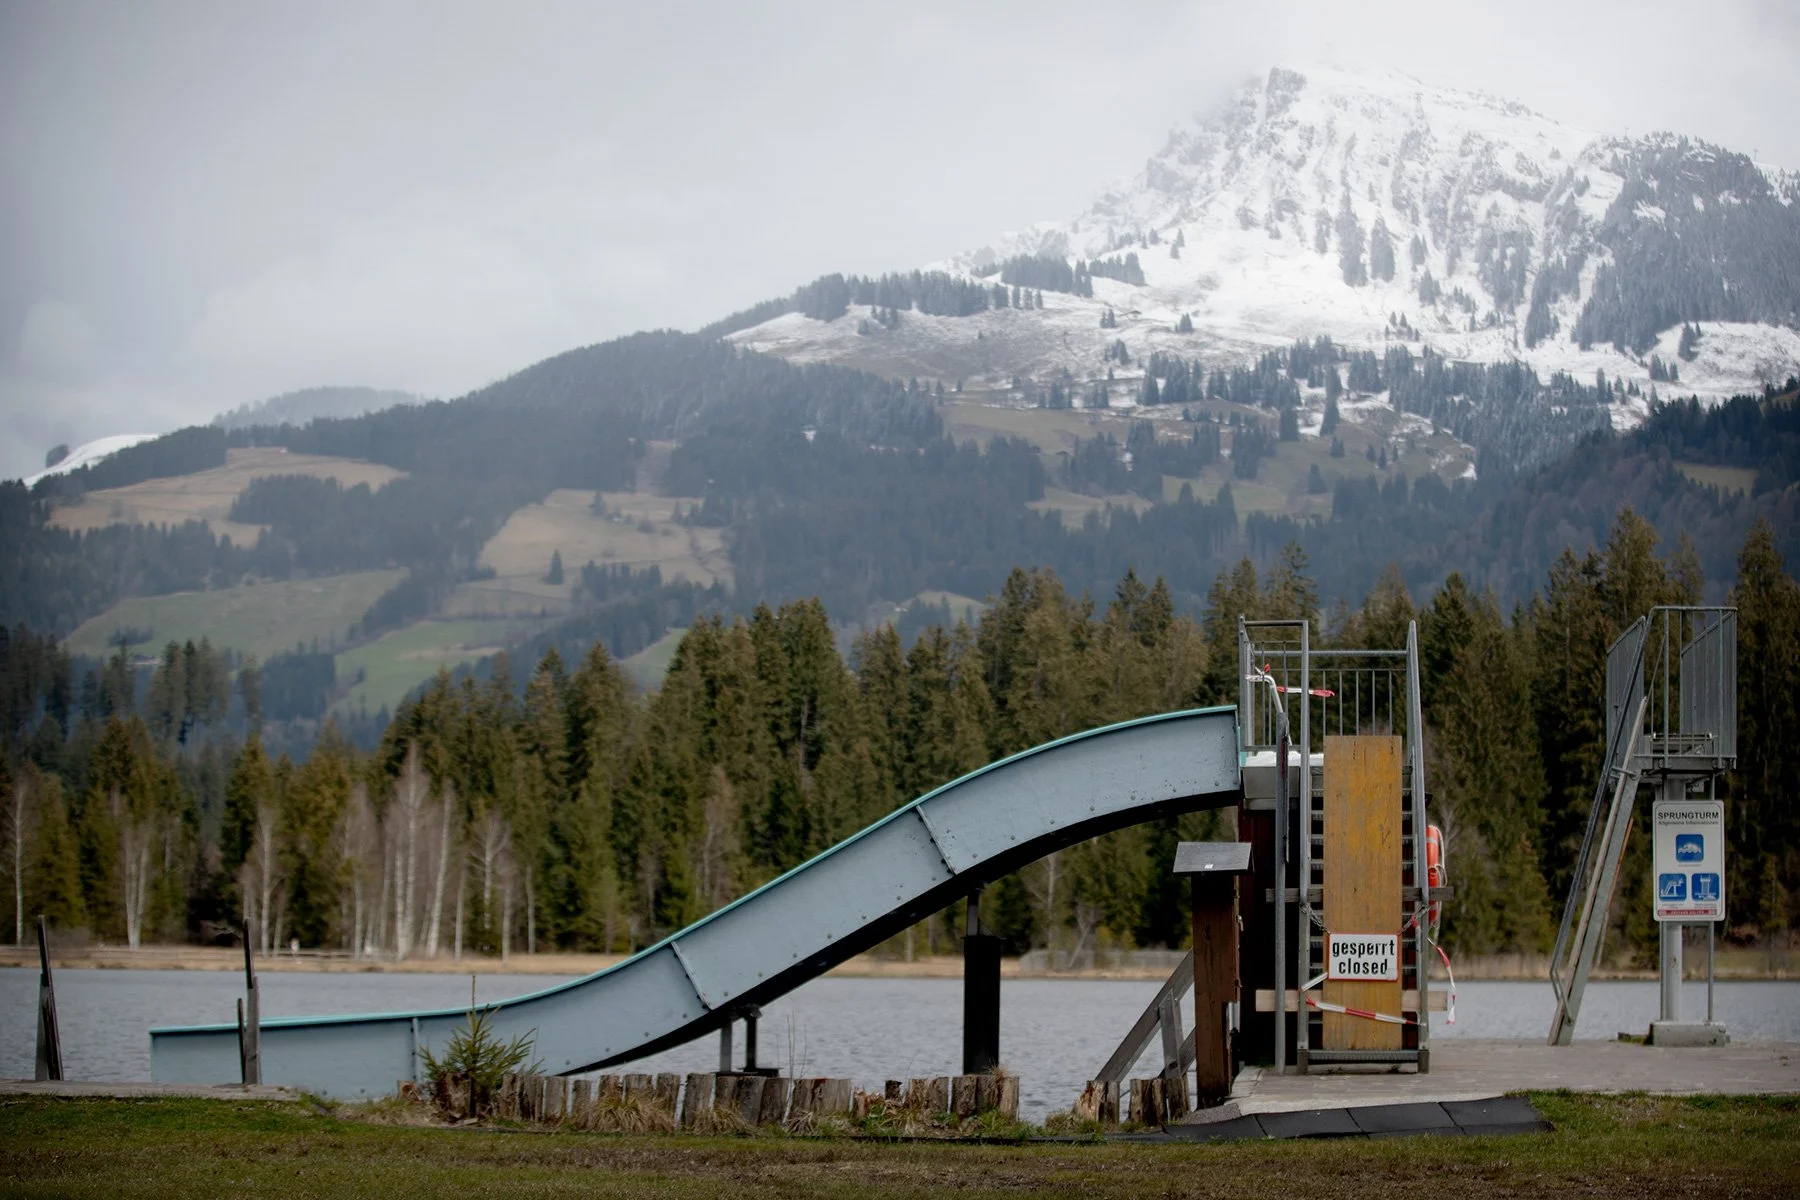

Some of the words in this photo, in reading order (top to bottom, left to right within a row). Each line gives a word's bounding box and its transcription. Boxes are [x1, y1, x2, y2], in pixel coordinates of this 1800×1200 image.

[1658, 812, 1719, 820] SPRUNGTURM
[1332, 940, 1395, 958] gesperrt
[1338, 958, 1388, 974] closed
